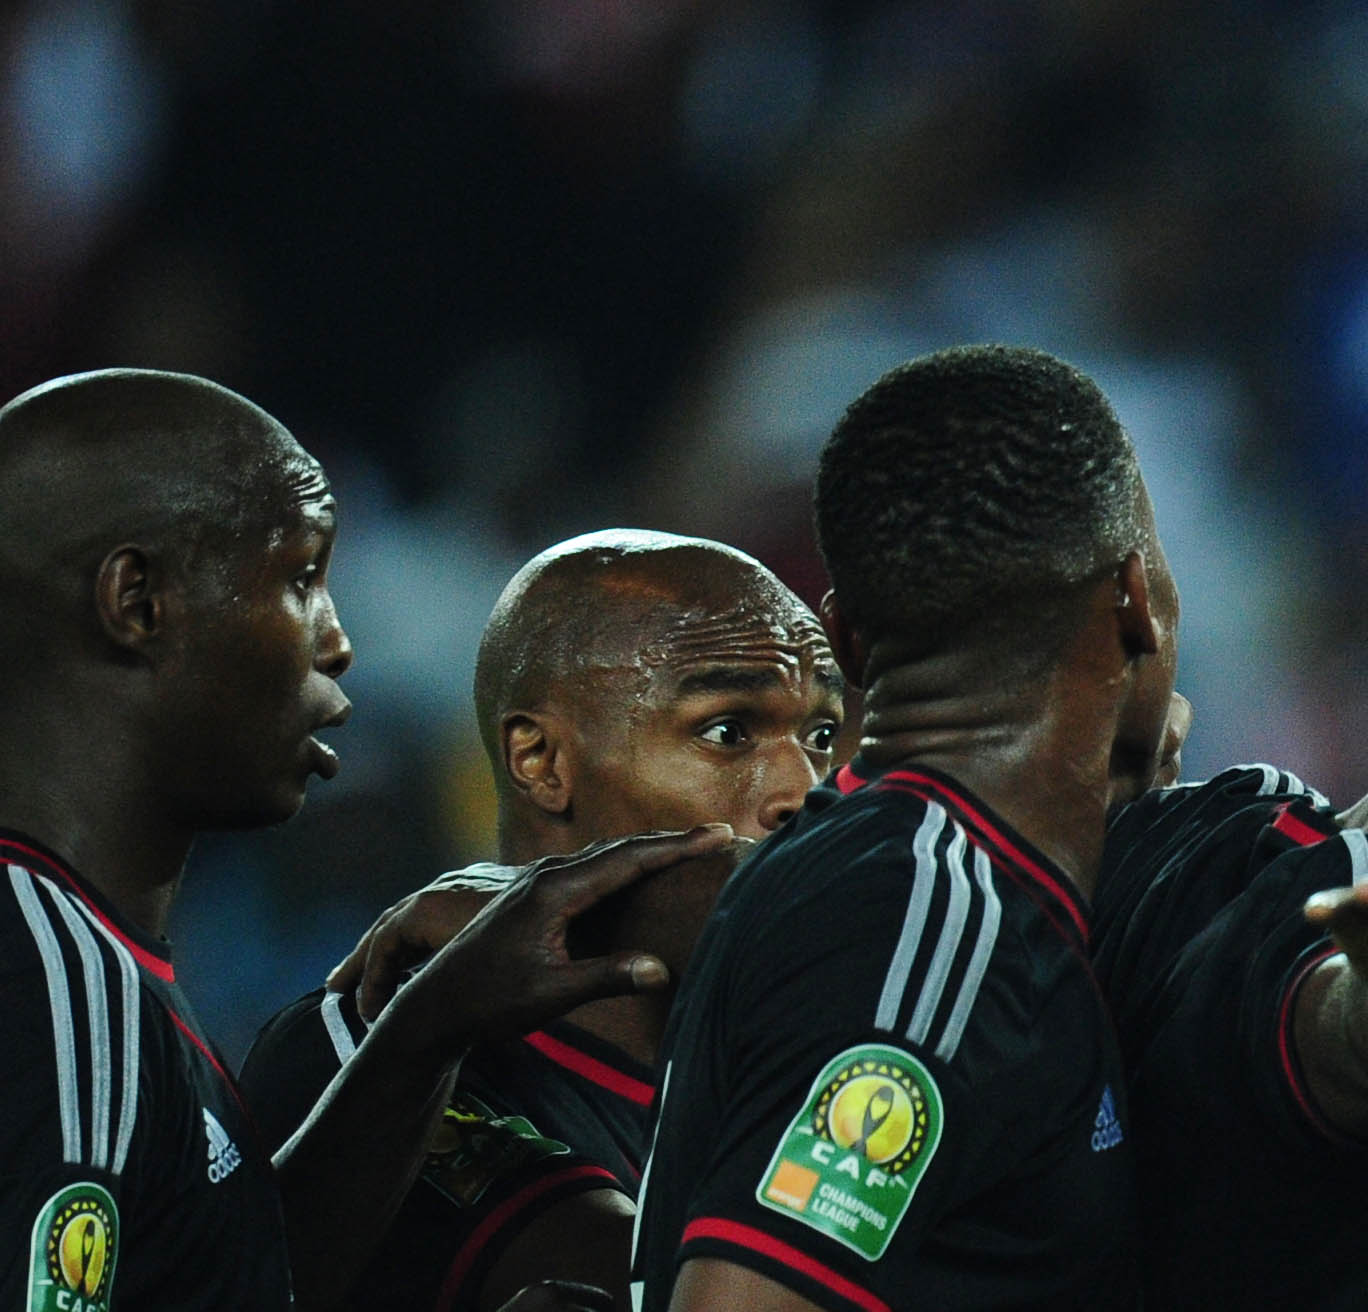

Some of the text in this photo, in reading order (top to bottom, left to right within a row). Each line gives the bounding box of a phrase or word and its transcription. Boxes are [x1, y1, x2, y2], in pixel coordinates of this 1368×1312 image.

[811, 1141, 887, 1188] CAF
[812, 1199, 860, 1232] LEAGUE
[819, 1184, 888, 1231] CHAMPIONS
